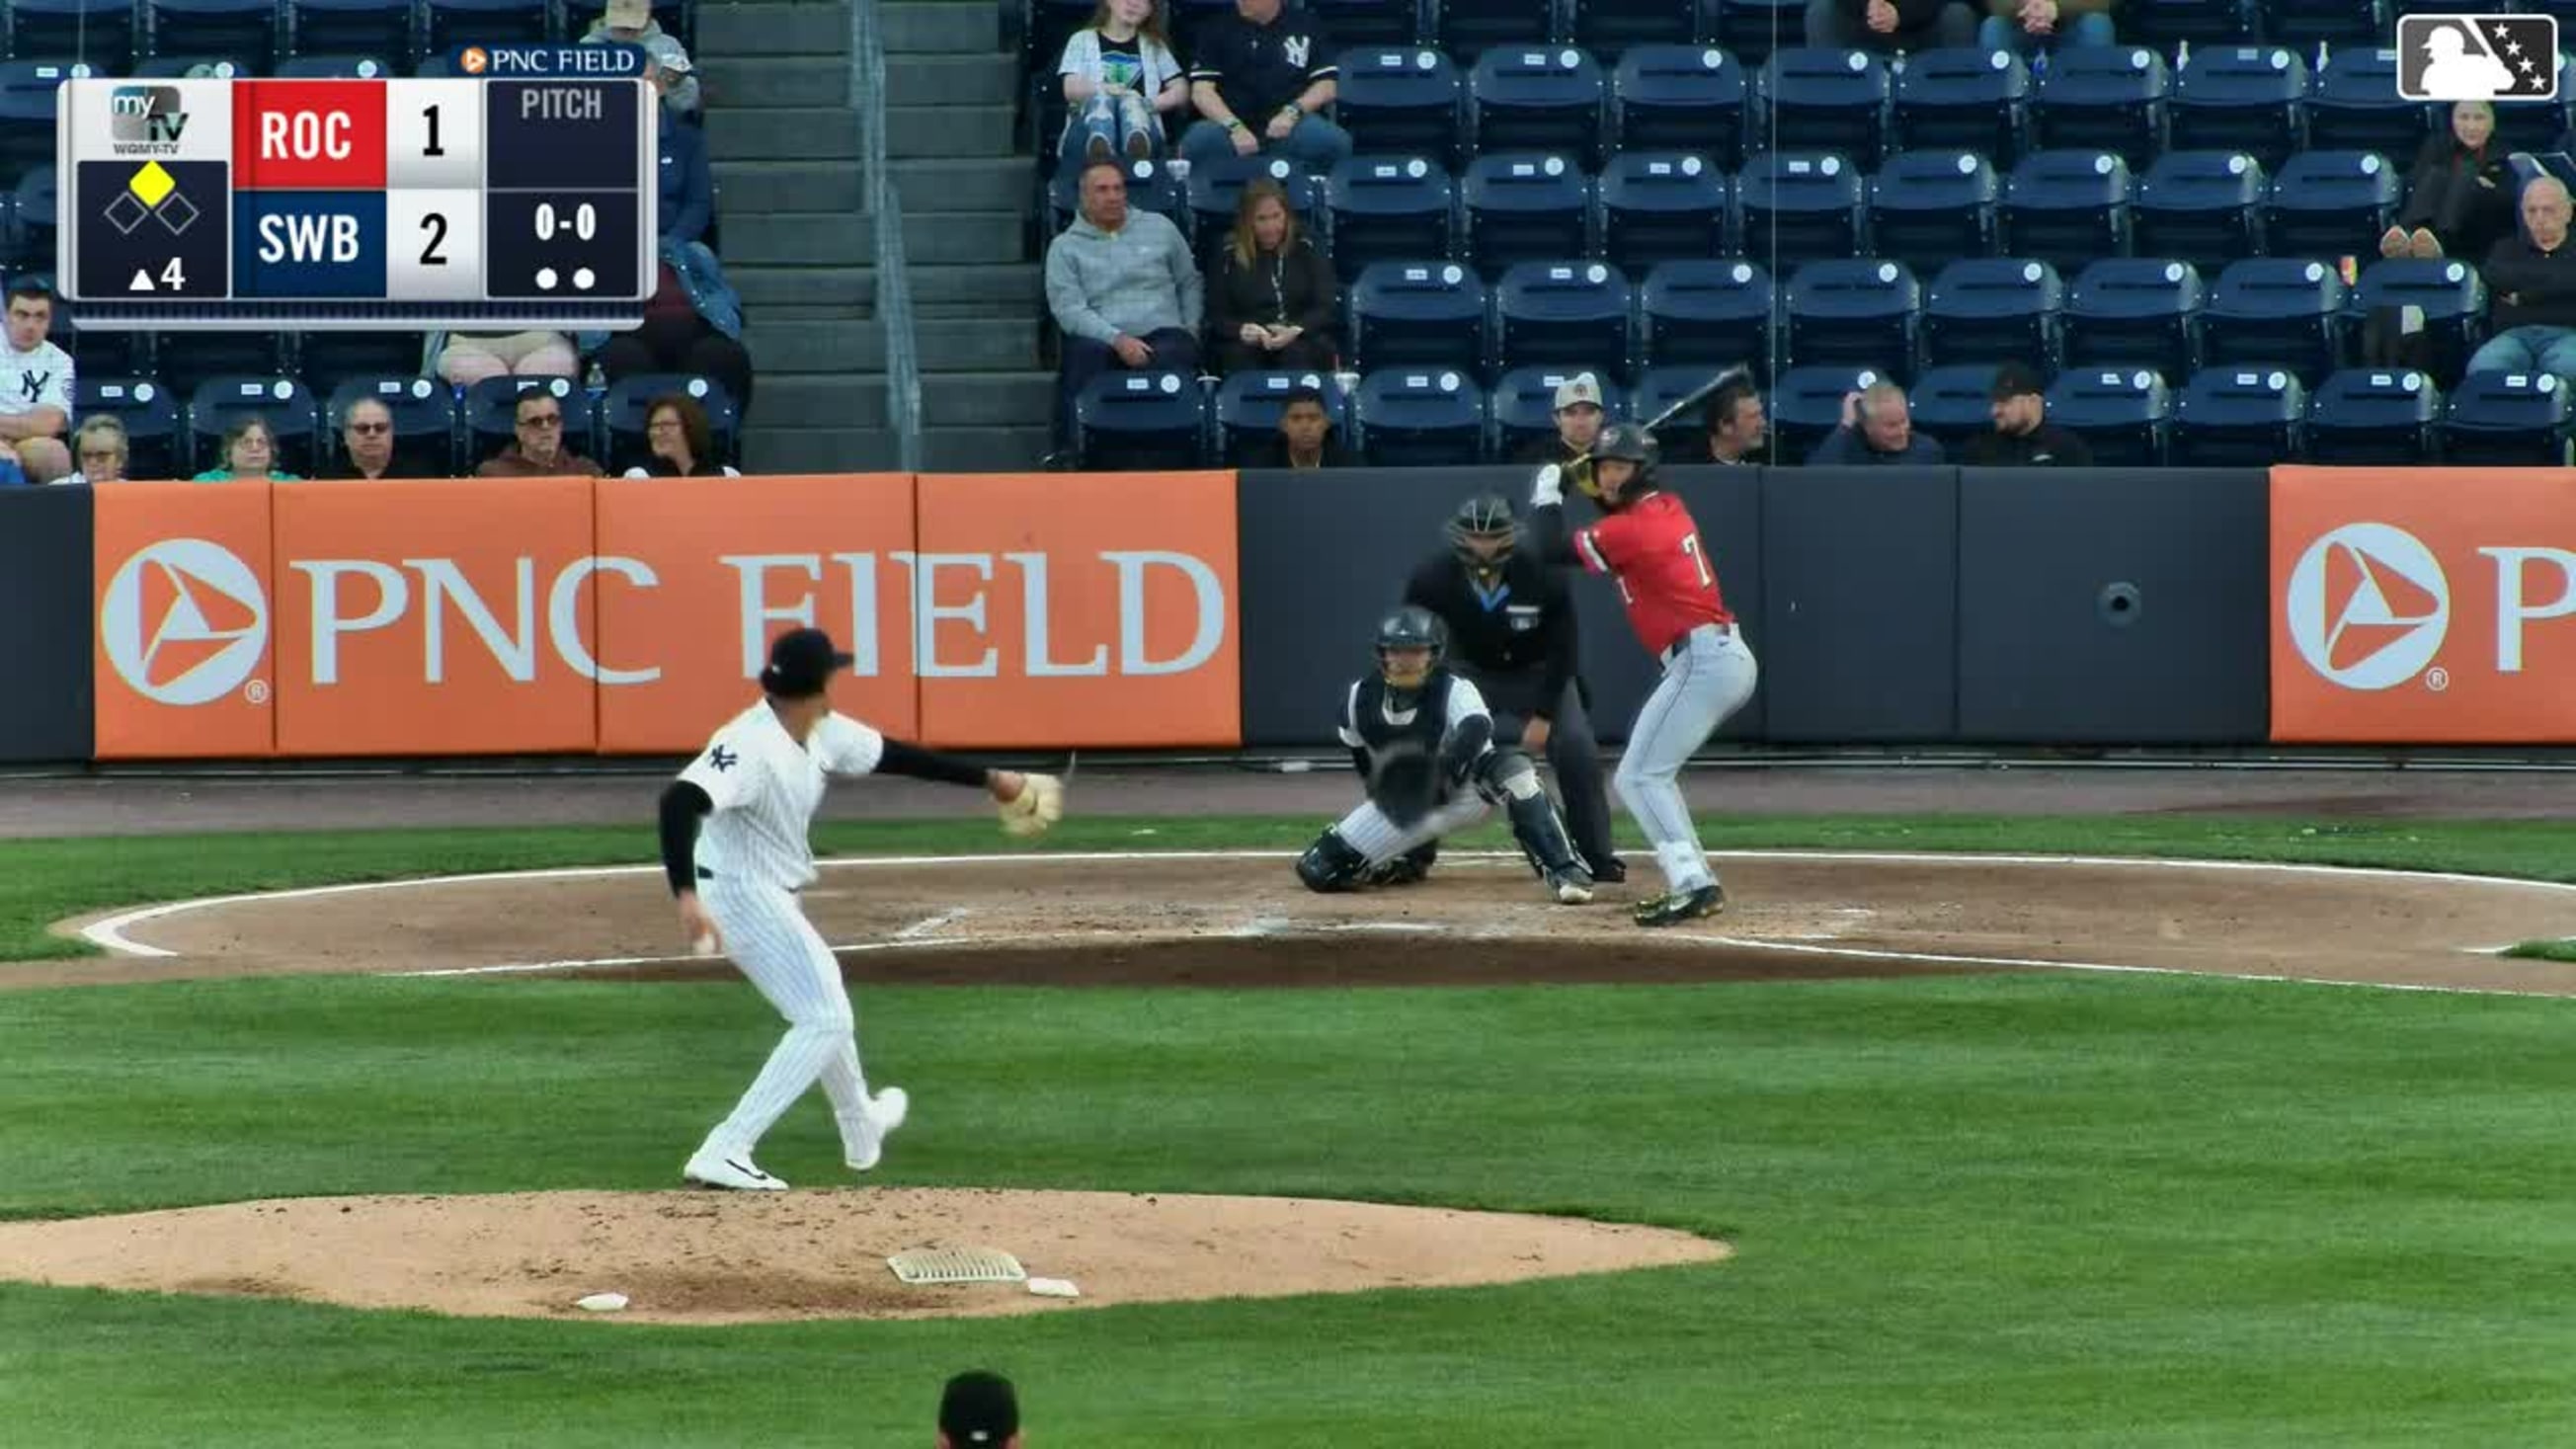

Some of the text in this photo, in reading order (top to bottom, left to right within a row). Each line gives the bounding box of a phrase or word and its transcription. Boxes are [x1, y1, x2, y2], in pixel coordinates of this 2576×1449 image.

[22, 369, 49, 403] NY
[1681, 532, 1712, 588] 7
[289, 549, 1225, 684] PNC FIELD
